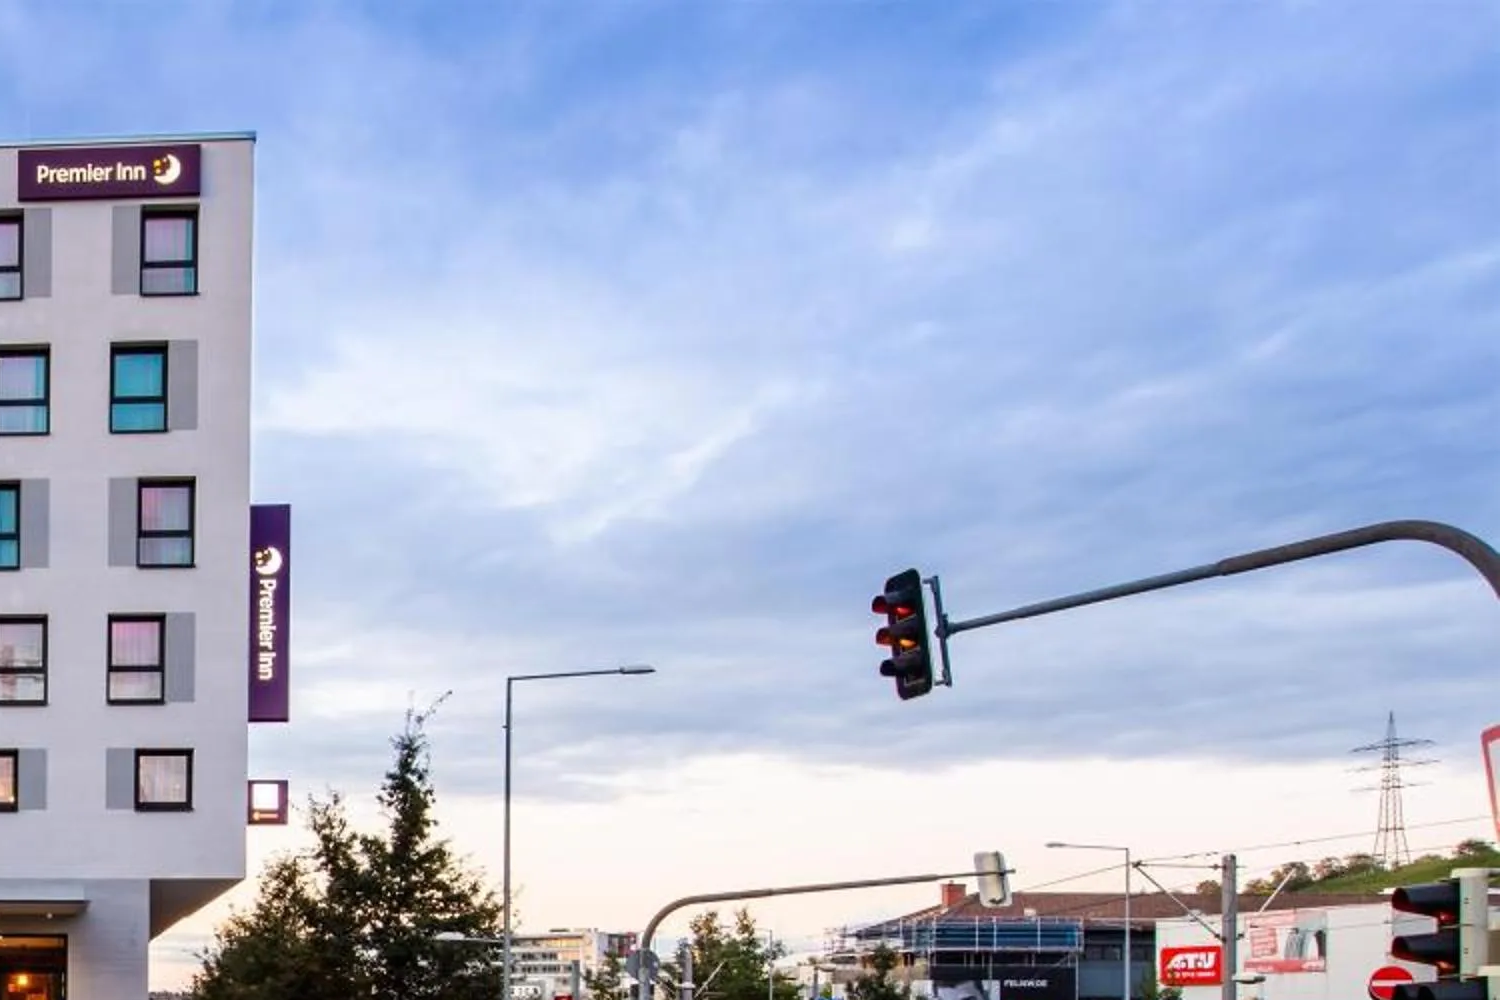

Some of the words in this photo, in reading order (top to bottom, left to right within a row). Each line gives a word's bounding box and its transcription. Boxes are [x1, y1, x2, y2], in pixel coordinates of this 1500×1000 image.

[36, 162, 113, 184] Premier
[116, 161, 147, 182] Inn
[258, 578, 277, 649] Premier
[258, 651, 275, 681] Inn
